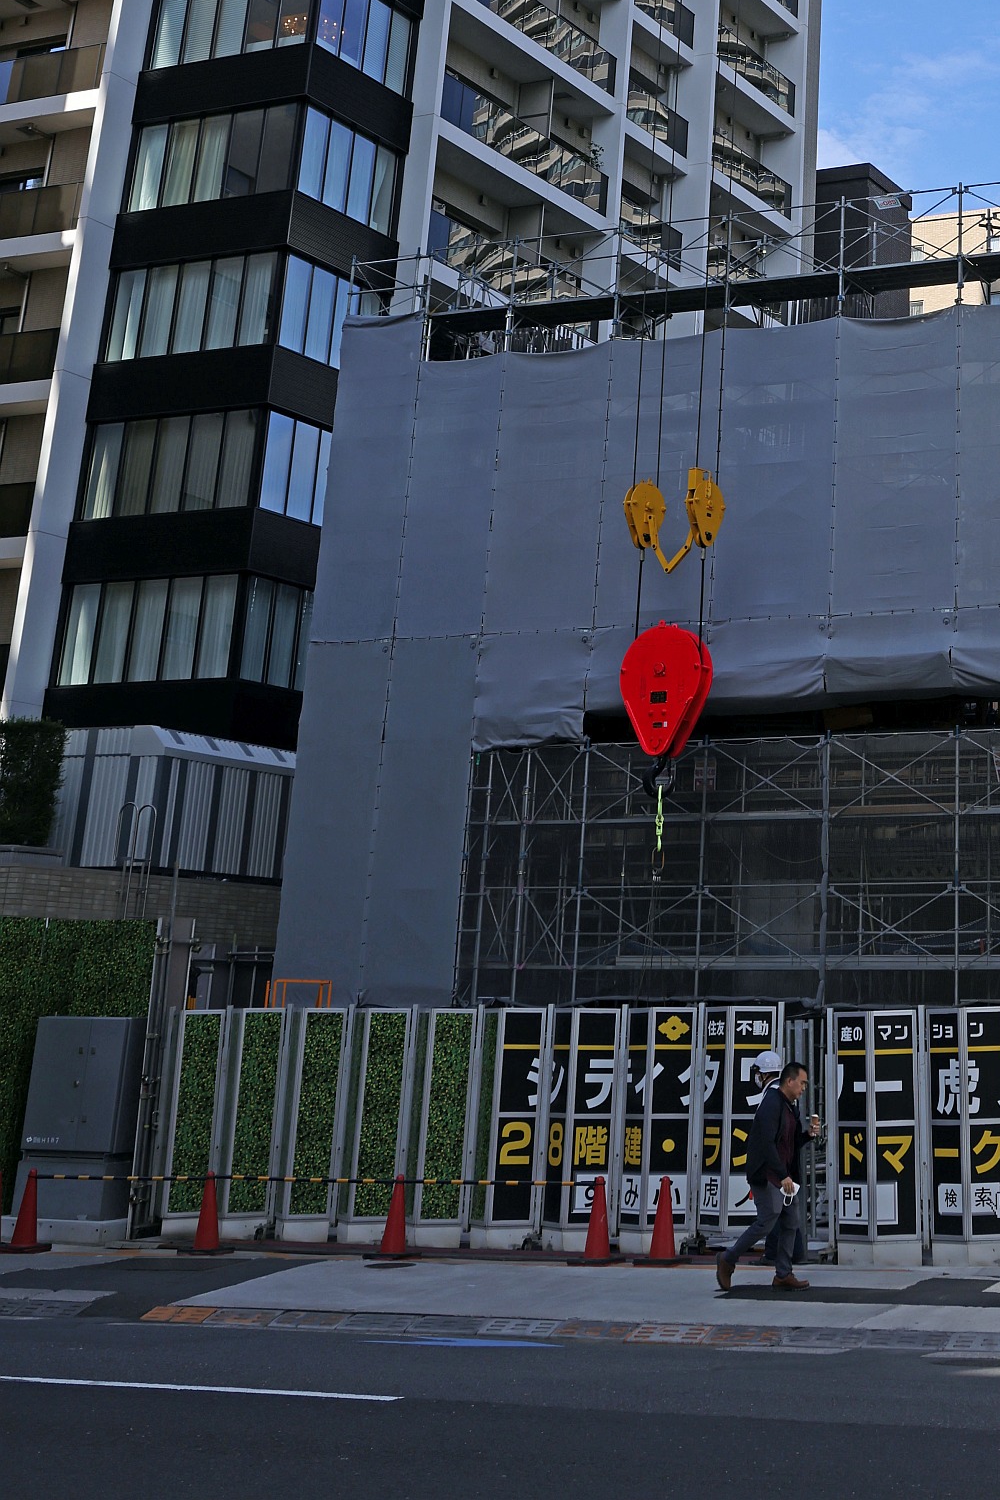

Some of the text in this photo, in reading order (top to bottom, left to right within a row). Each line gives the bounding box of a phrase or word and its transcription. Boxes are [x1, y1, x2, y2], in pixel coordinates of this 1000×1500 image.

[708, 1020, 984, 1042] 住友不動産のマンション
[944, 1187, 992, 1208] 検索
